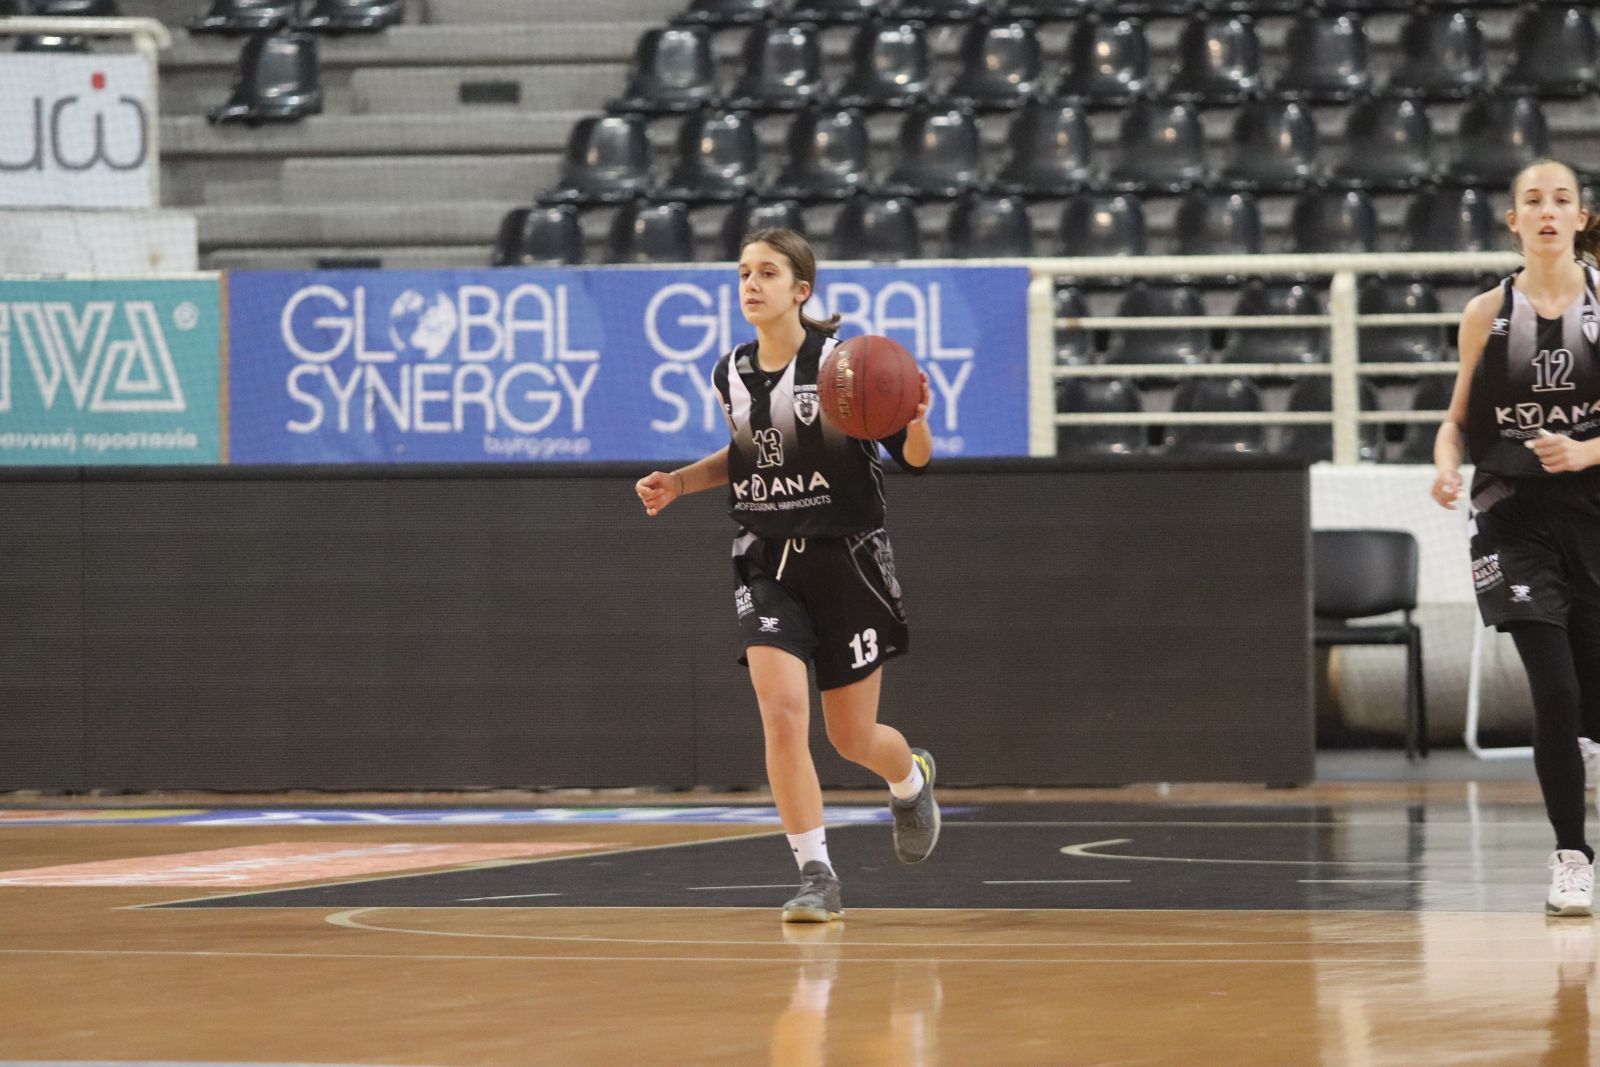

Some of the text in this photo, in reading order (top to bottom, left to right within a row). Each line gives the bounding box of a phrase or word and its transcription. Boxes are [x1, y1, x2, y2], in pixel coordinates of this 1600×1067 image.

[280, 283, 600, 362] GLOBAL
[1531, 348, 1576, 392] 12
[286, 361, 600, 433] SYNERGY
[752, 427, 784, 469] 13
[848, 628, 879, 669] 13
